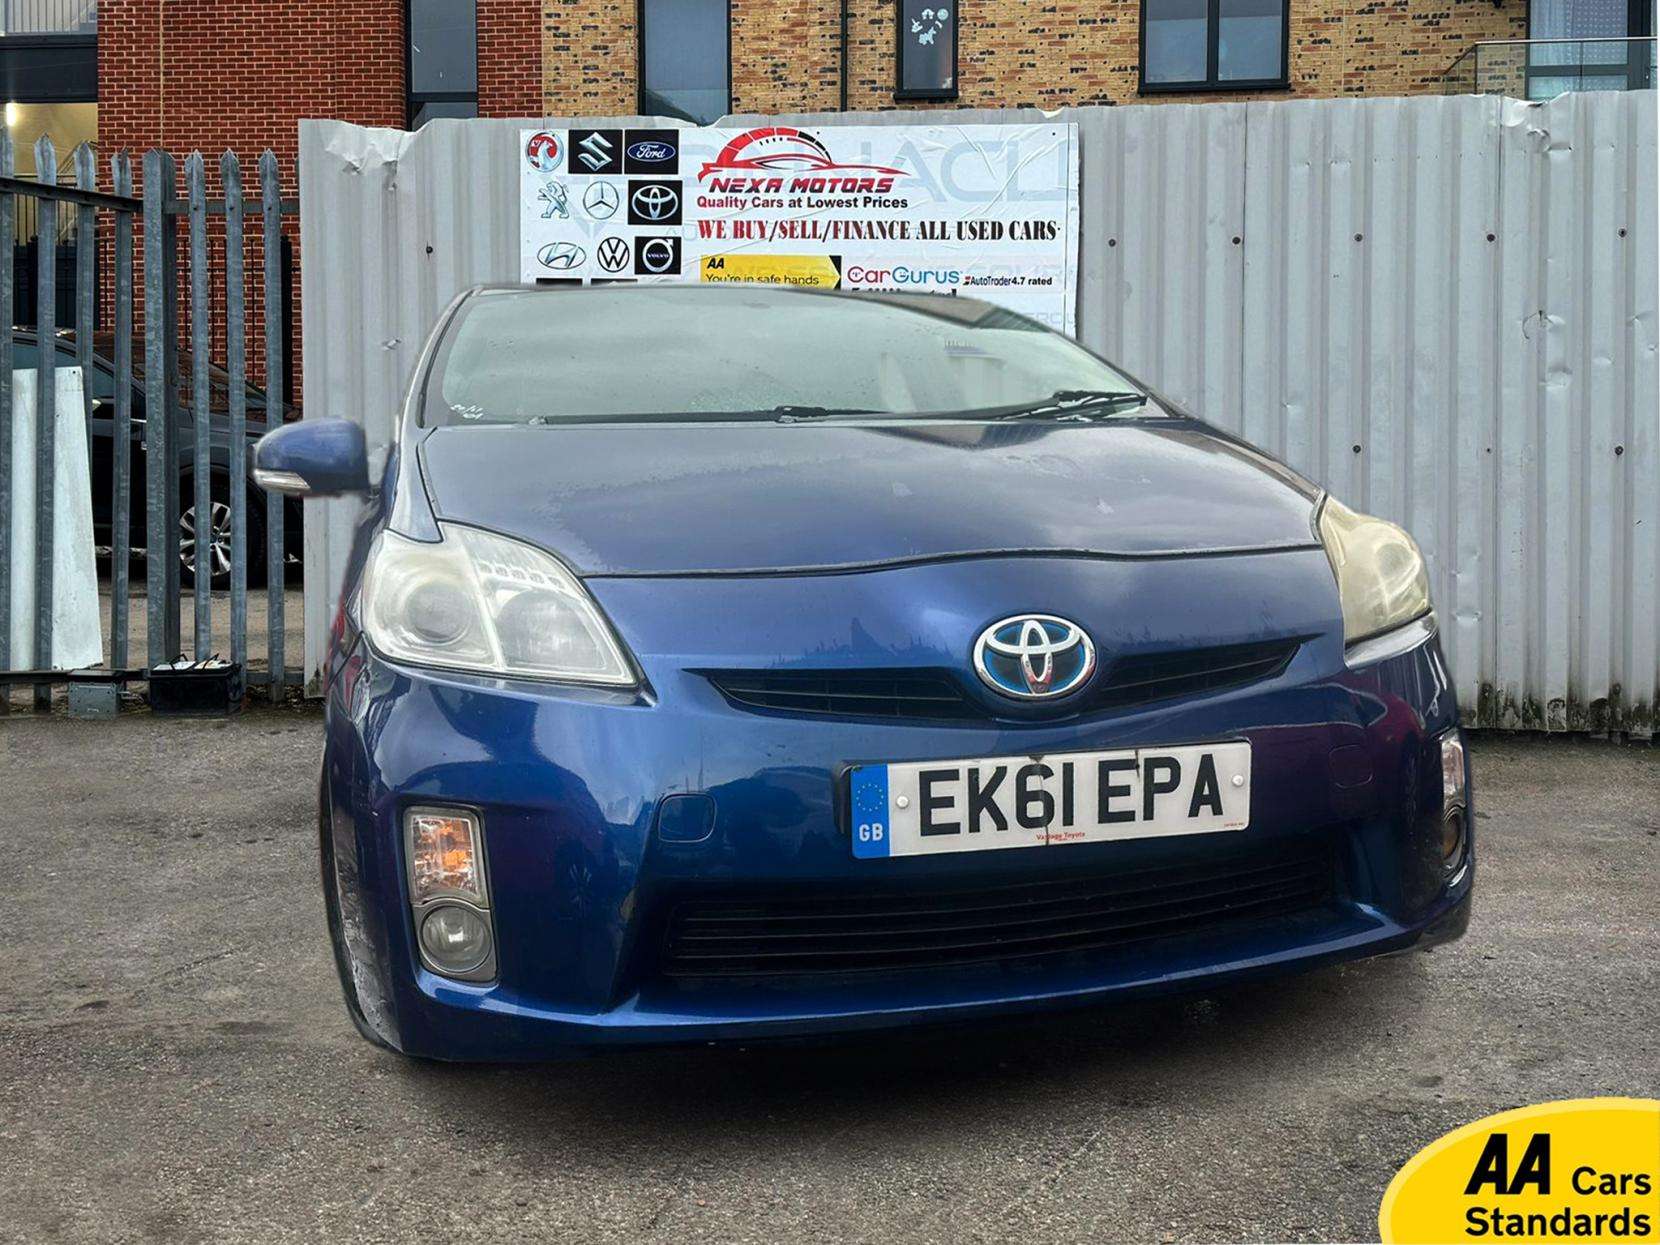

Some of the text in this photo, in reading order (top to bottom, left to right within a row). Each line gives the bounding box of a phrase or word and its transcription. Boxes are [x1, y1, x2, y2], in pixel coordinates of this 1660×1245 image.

[636, 144, 666, 158] Ford
[708, 178, 894, 193] NEXA MOTORS
[697, 196, 908, 210] Quality Cars at Lowest Prices
[698, 220, 726, 240] WE
[916, 220, 950, 240] ALL
[956, 220, 1003, 240] USED
[1009, 220, 1057, 240] CARS
[706, 258, 725, 269] AA
[706, 273, 820, 285] You're in safe hands
[847, 266, 960, 284] CarGurus
[1028, 276, 1052, 286] rated
[919, 753, 1224, 837] EK61 EPA
[859, 823, 883, 841] GB
